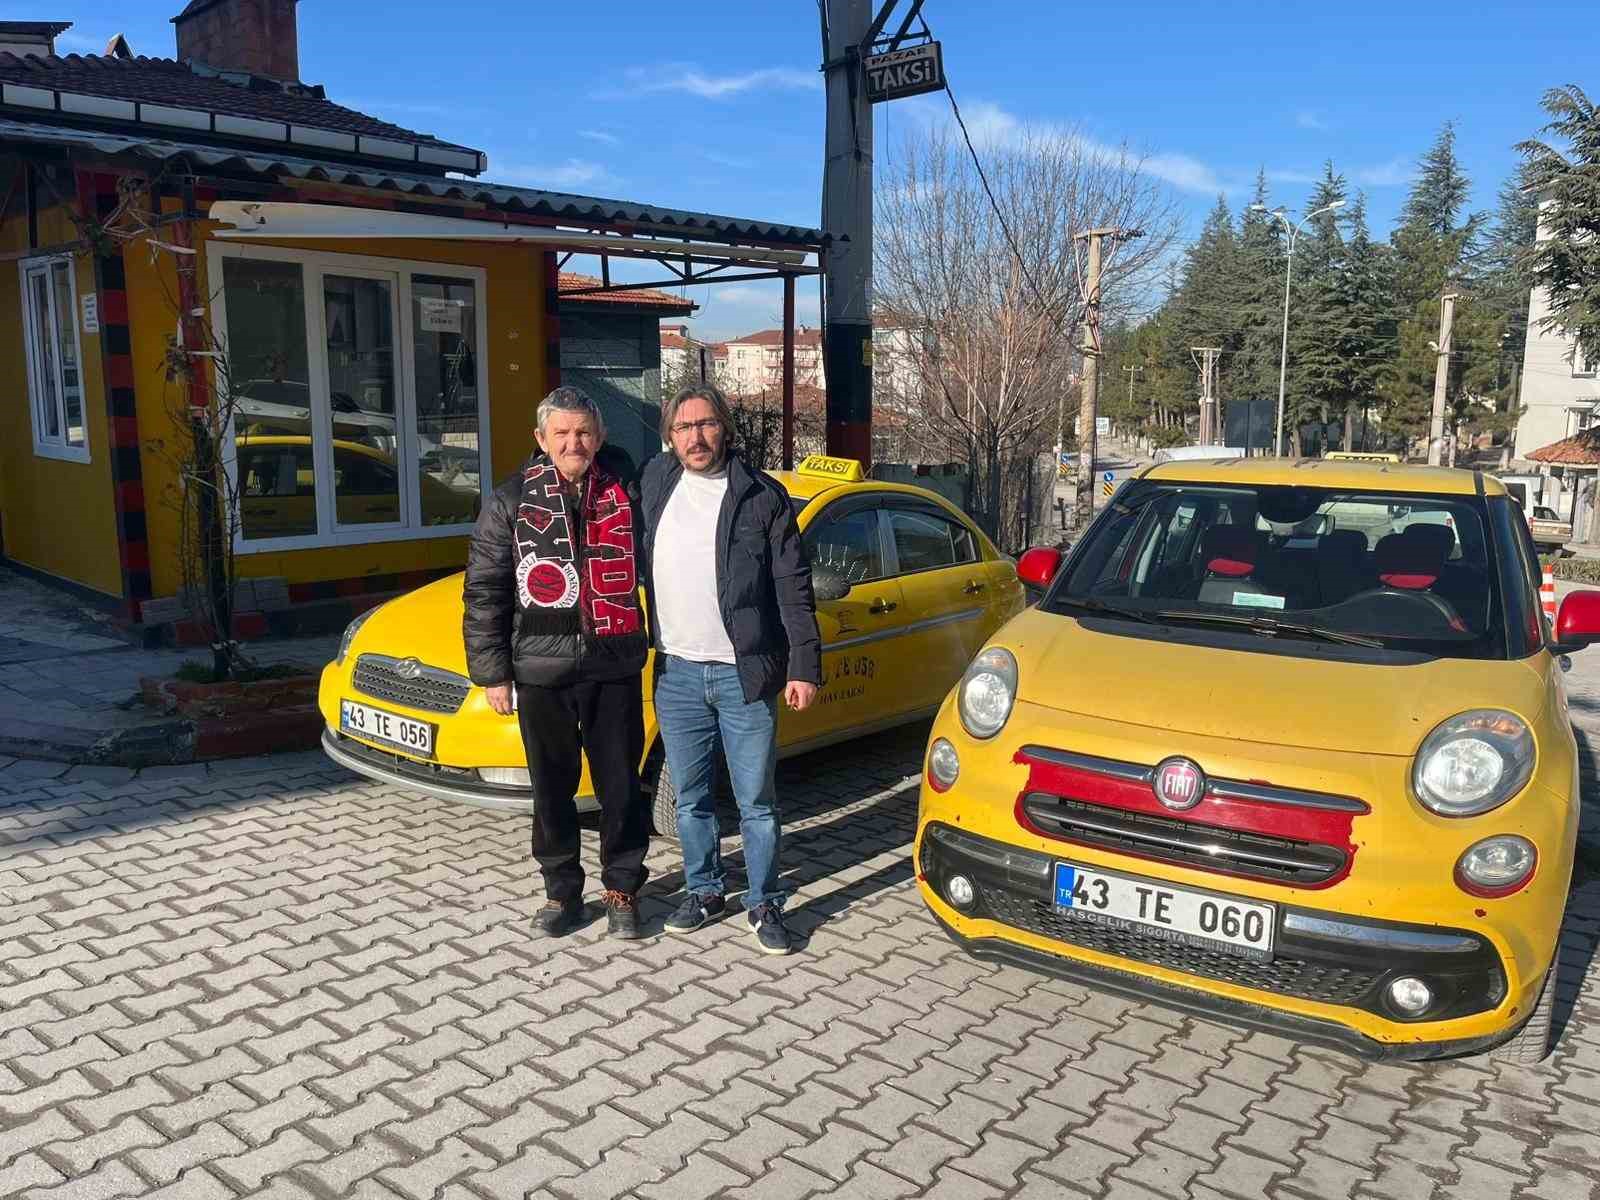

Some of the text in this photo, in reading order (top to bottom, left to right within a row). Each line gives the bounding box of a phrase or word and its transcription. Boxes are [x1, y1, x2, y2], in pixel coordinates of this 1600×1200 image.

[350, 705, 365, 729] 43
[374, 712, 392, 737] TE
[400, 720, 427, 748] 056
[1164, 773, 1194, 797] FIAT
[1060, 874, 1264, 943] TR 43 TE 060
